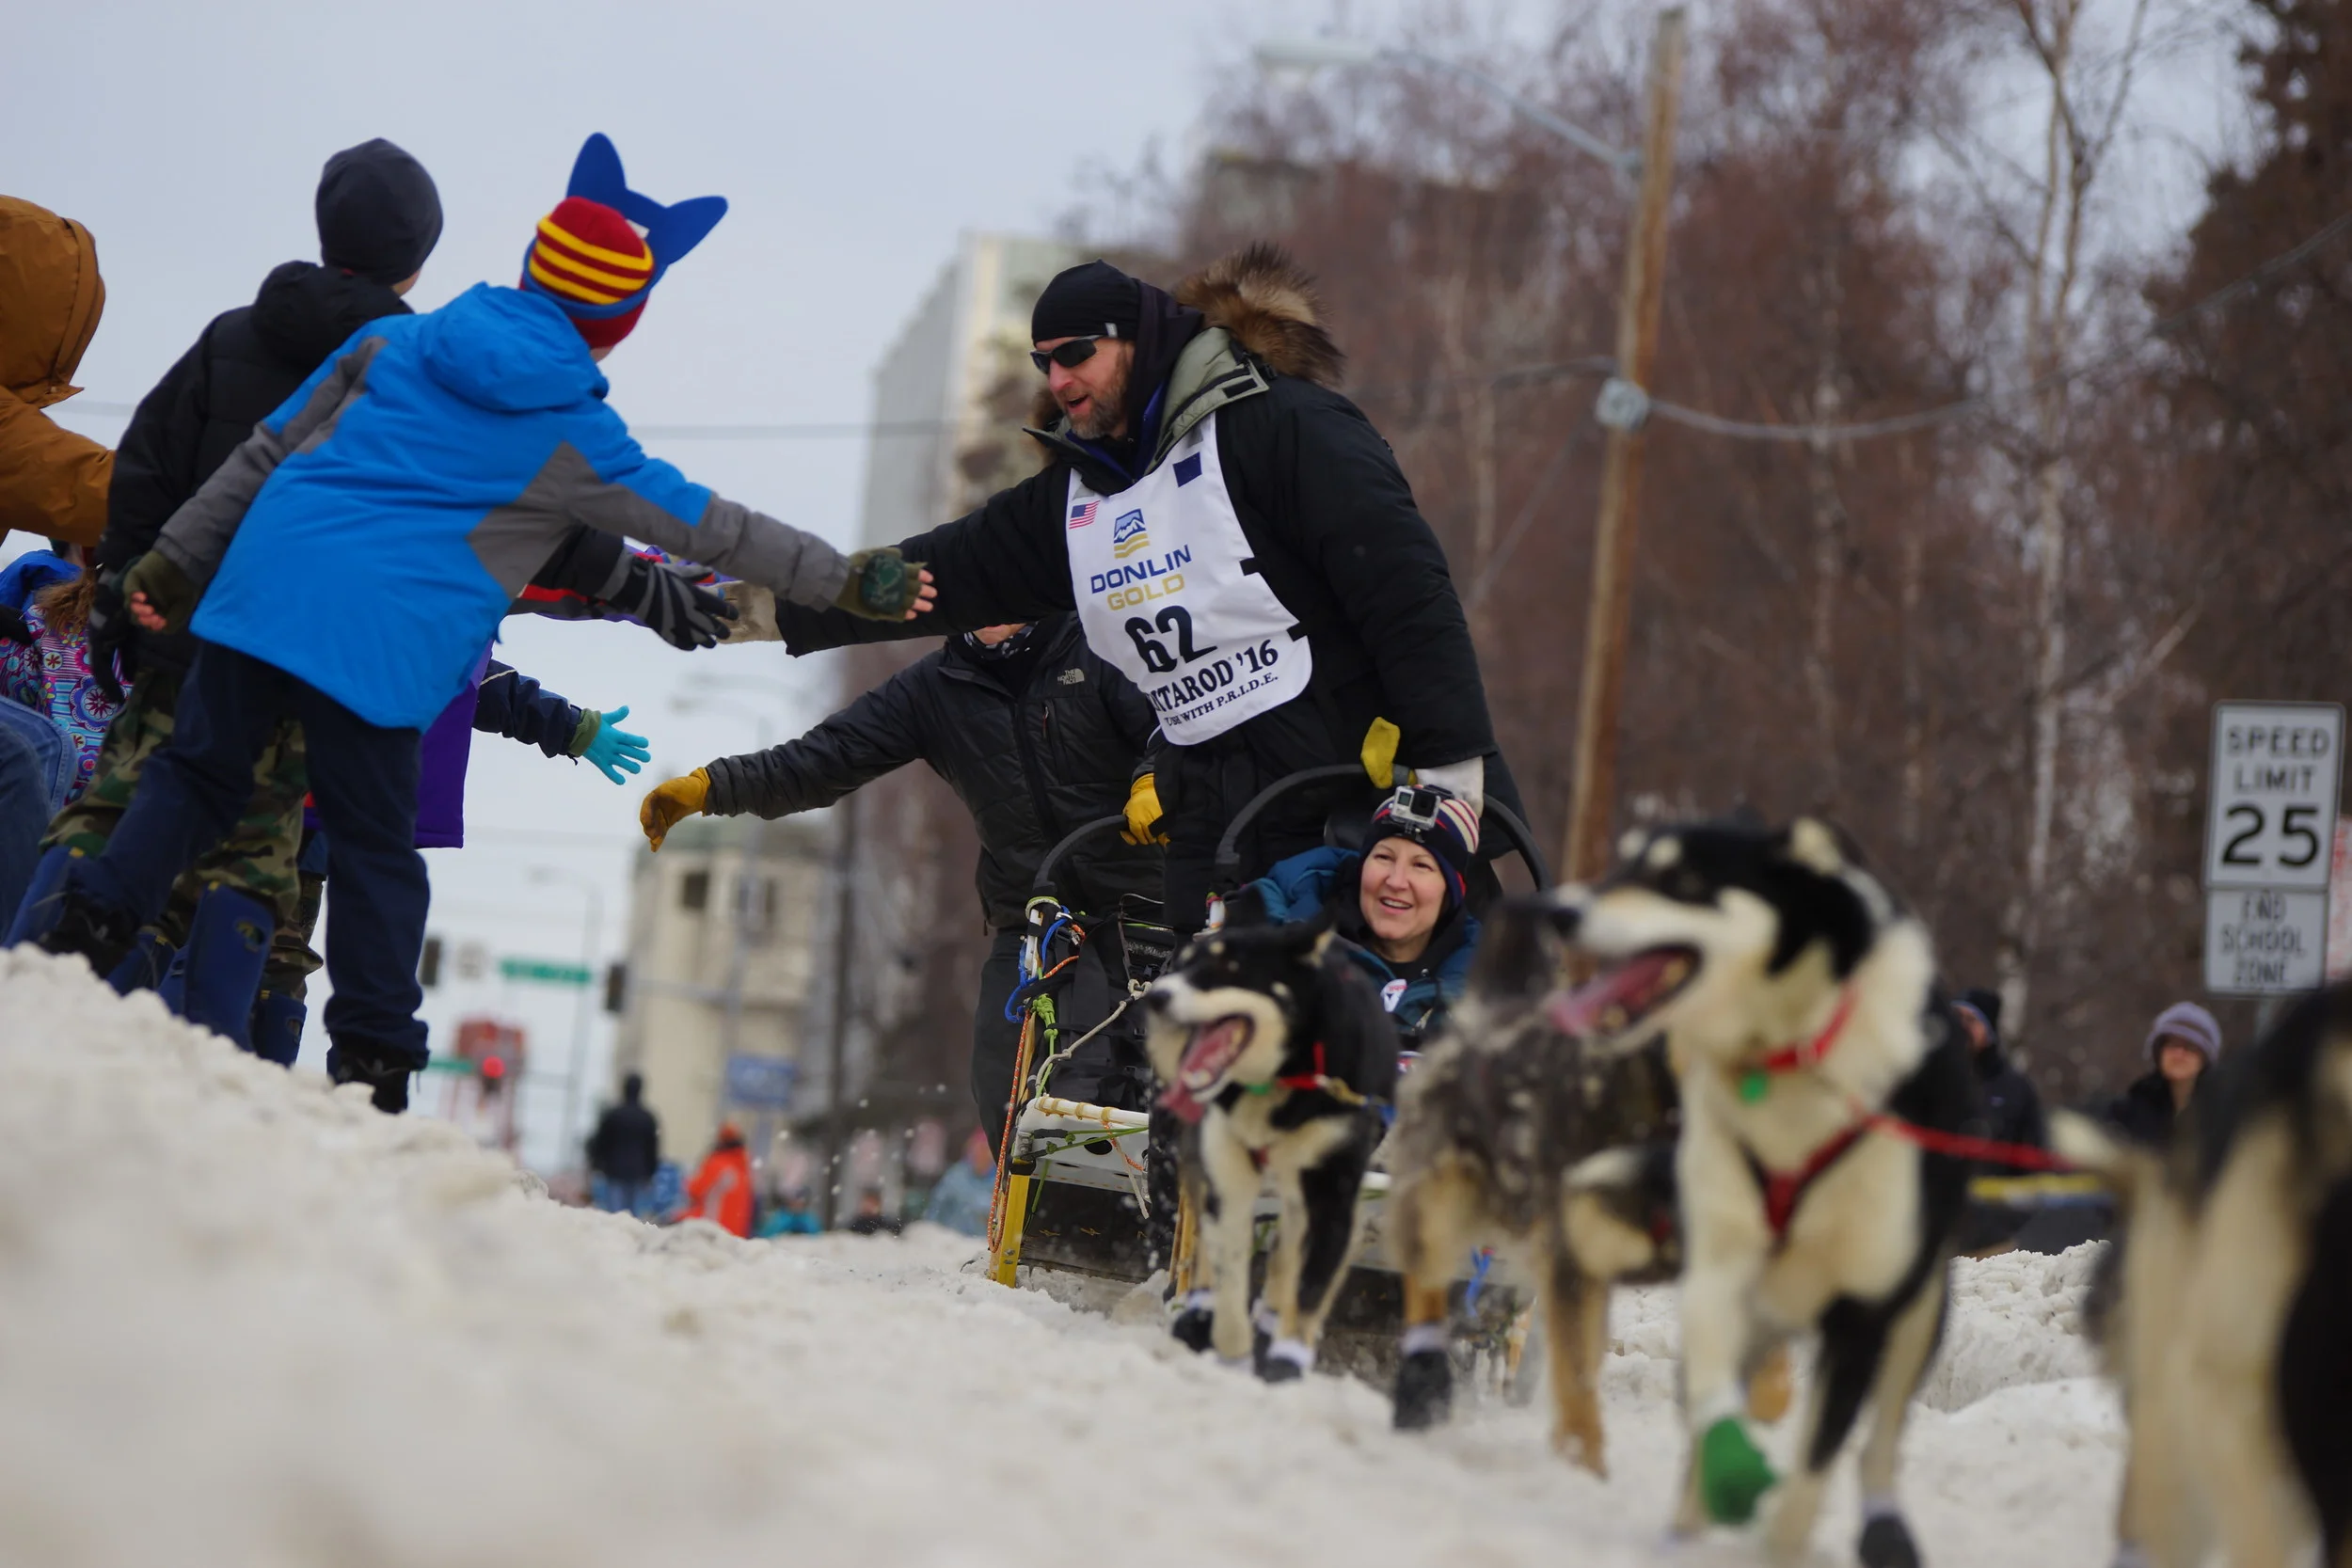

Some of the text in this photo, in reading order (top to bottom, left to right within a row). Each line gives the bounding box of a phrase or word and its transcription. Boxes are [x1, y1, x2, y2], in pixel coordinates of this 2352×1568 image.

[1090, 544, 1192, 594] DONLIN
[1107, 573, 1185, 611] GOLD
[1124, 605, 1218, 673] 62
[1235, 639, 1279, 673] '16
[1180, 701, 1216, 721] WITH
[1216, 673, 1279, 707] P.R.I.D.E.
[2226, 726, 2331, 759] SPEED
[2233, 764, 2318, 795] LIMIT
[2221, 803, 2322, 868] 25
[2241, 893, 2286, 922] END
[2220, 923, 2306, 956] SCHOOL
[2233, 958, 2291, 987] ZONE
